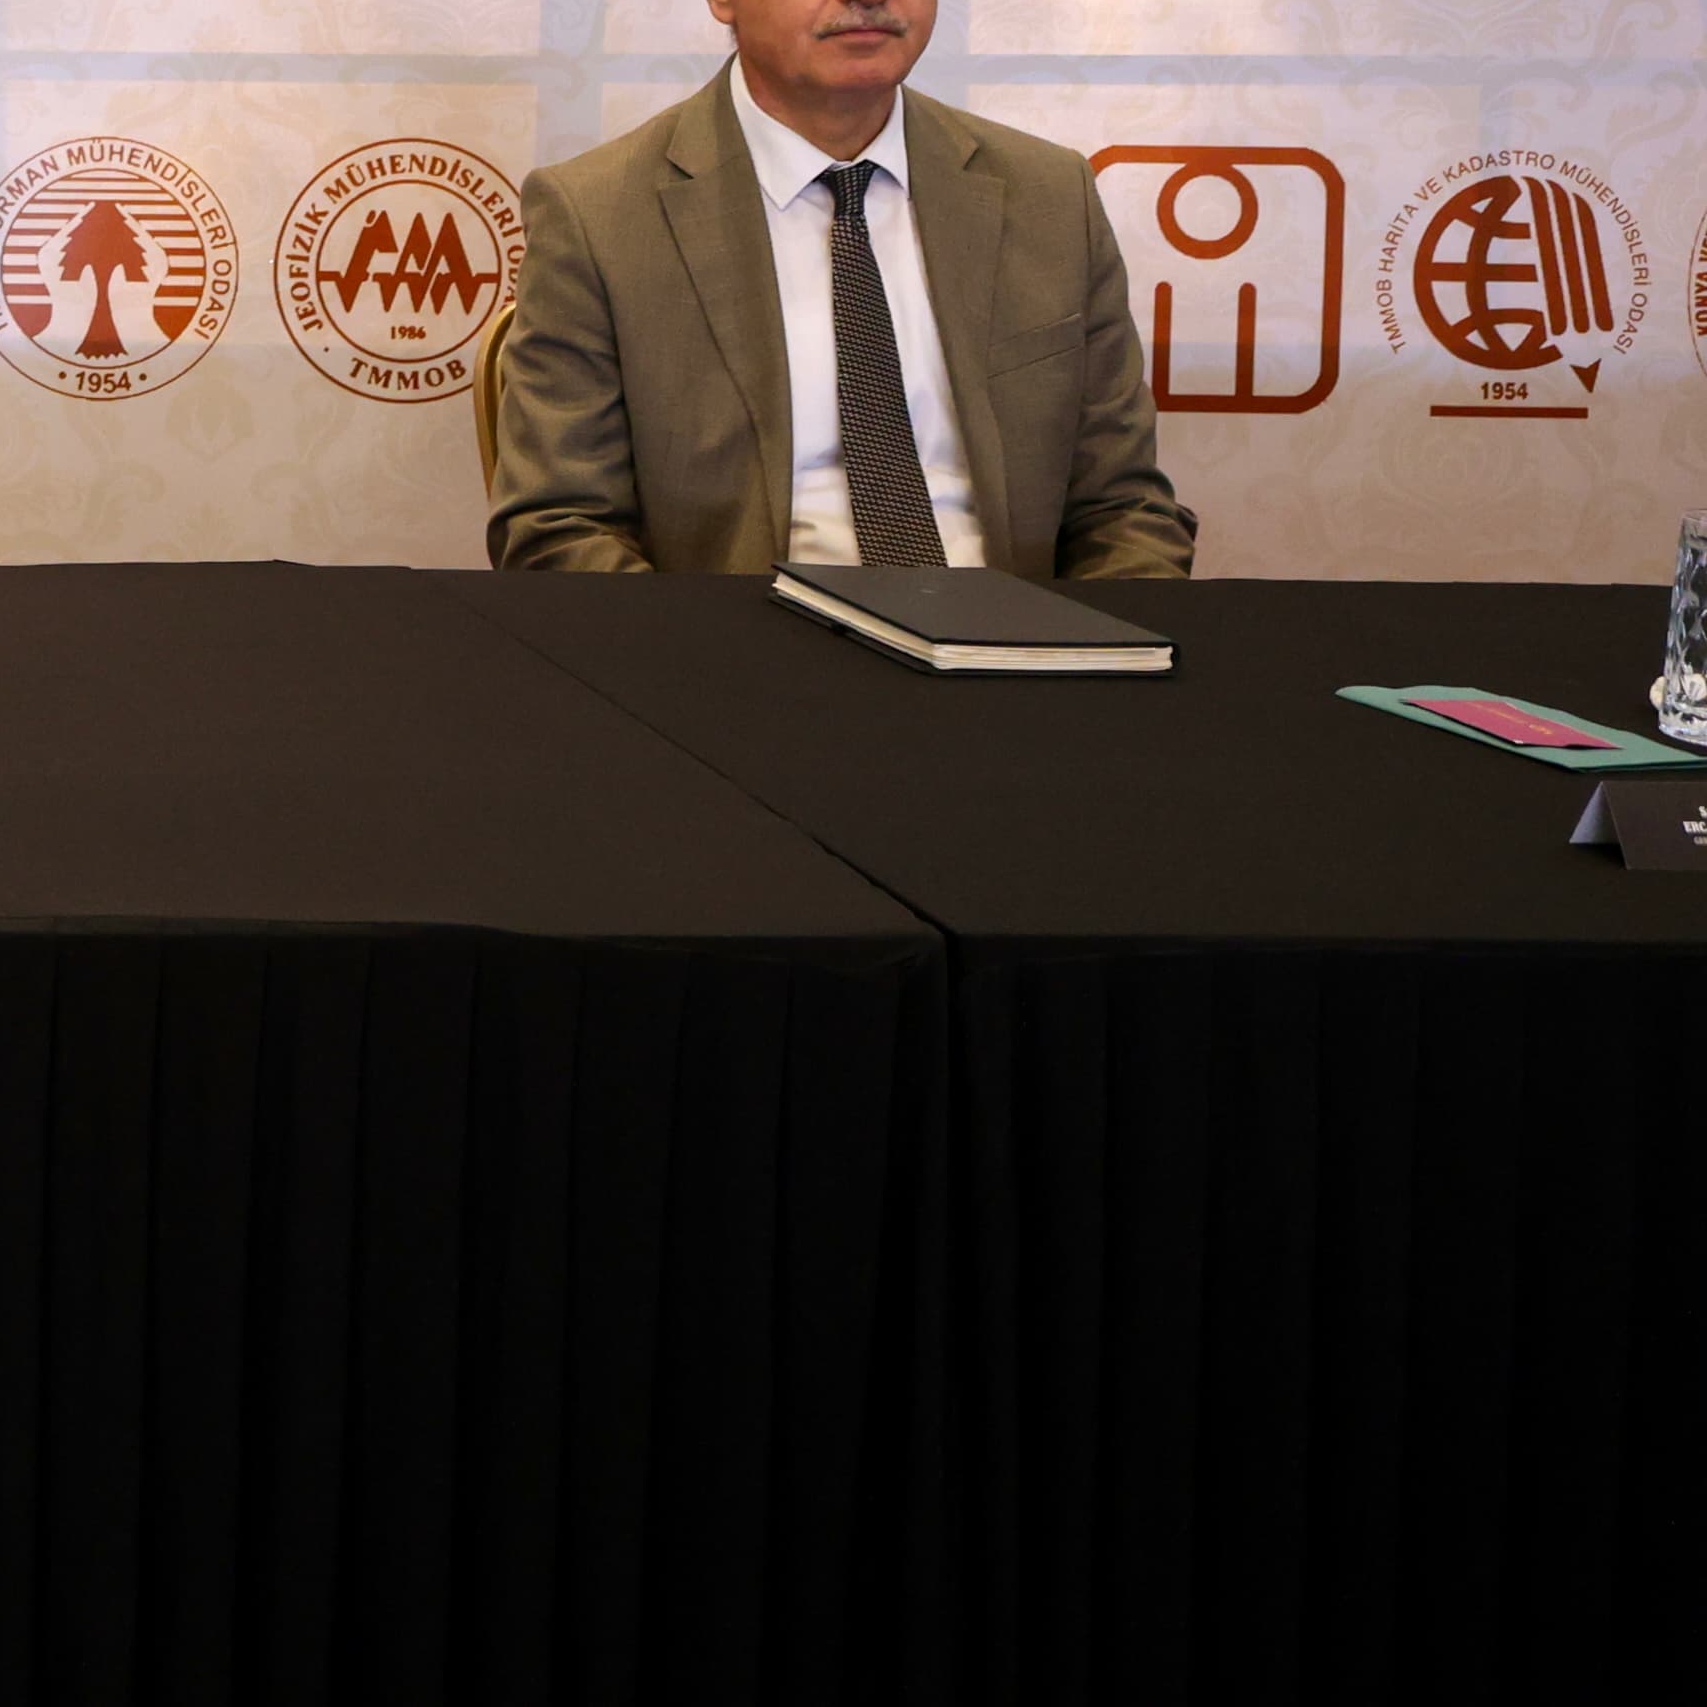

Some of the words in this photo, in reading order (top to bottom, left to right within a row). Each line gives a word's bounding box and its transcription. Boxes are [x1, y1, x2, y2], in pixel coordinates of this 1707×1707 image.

[1414, 177, 1442, 201] VE
[1443, 150, 1555, 183] KADASTRO
[66, 138, 236, 250] MÜHENDİSLERİ
[193, 259, 232, 340] ODASI
[286, 203, 329, 332] JEOFİZİK
[323, 153, 523, 238] MÜHENDİSLERİ
[1378, 204, 1419, 273] HARİTA
[1559, 160, 1652, 286] MÜHENDİSLERİ
[390, 325, 426, 339] 1986
[1375, 279, 1405, 354] TMMOB
[1613, 292, 1648, 355] ODASI
[75, 371, 131, 393] 1954
[349, 357, 467, 390] TMMOB
[1480, 381, 1528, 400] 1954
